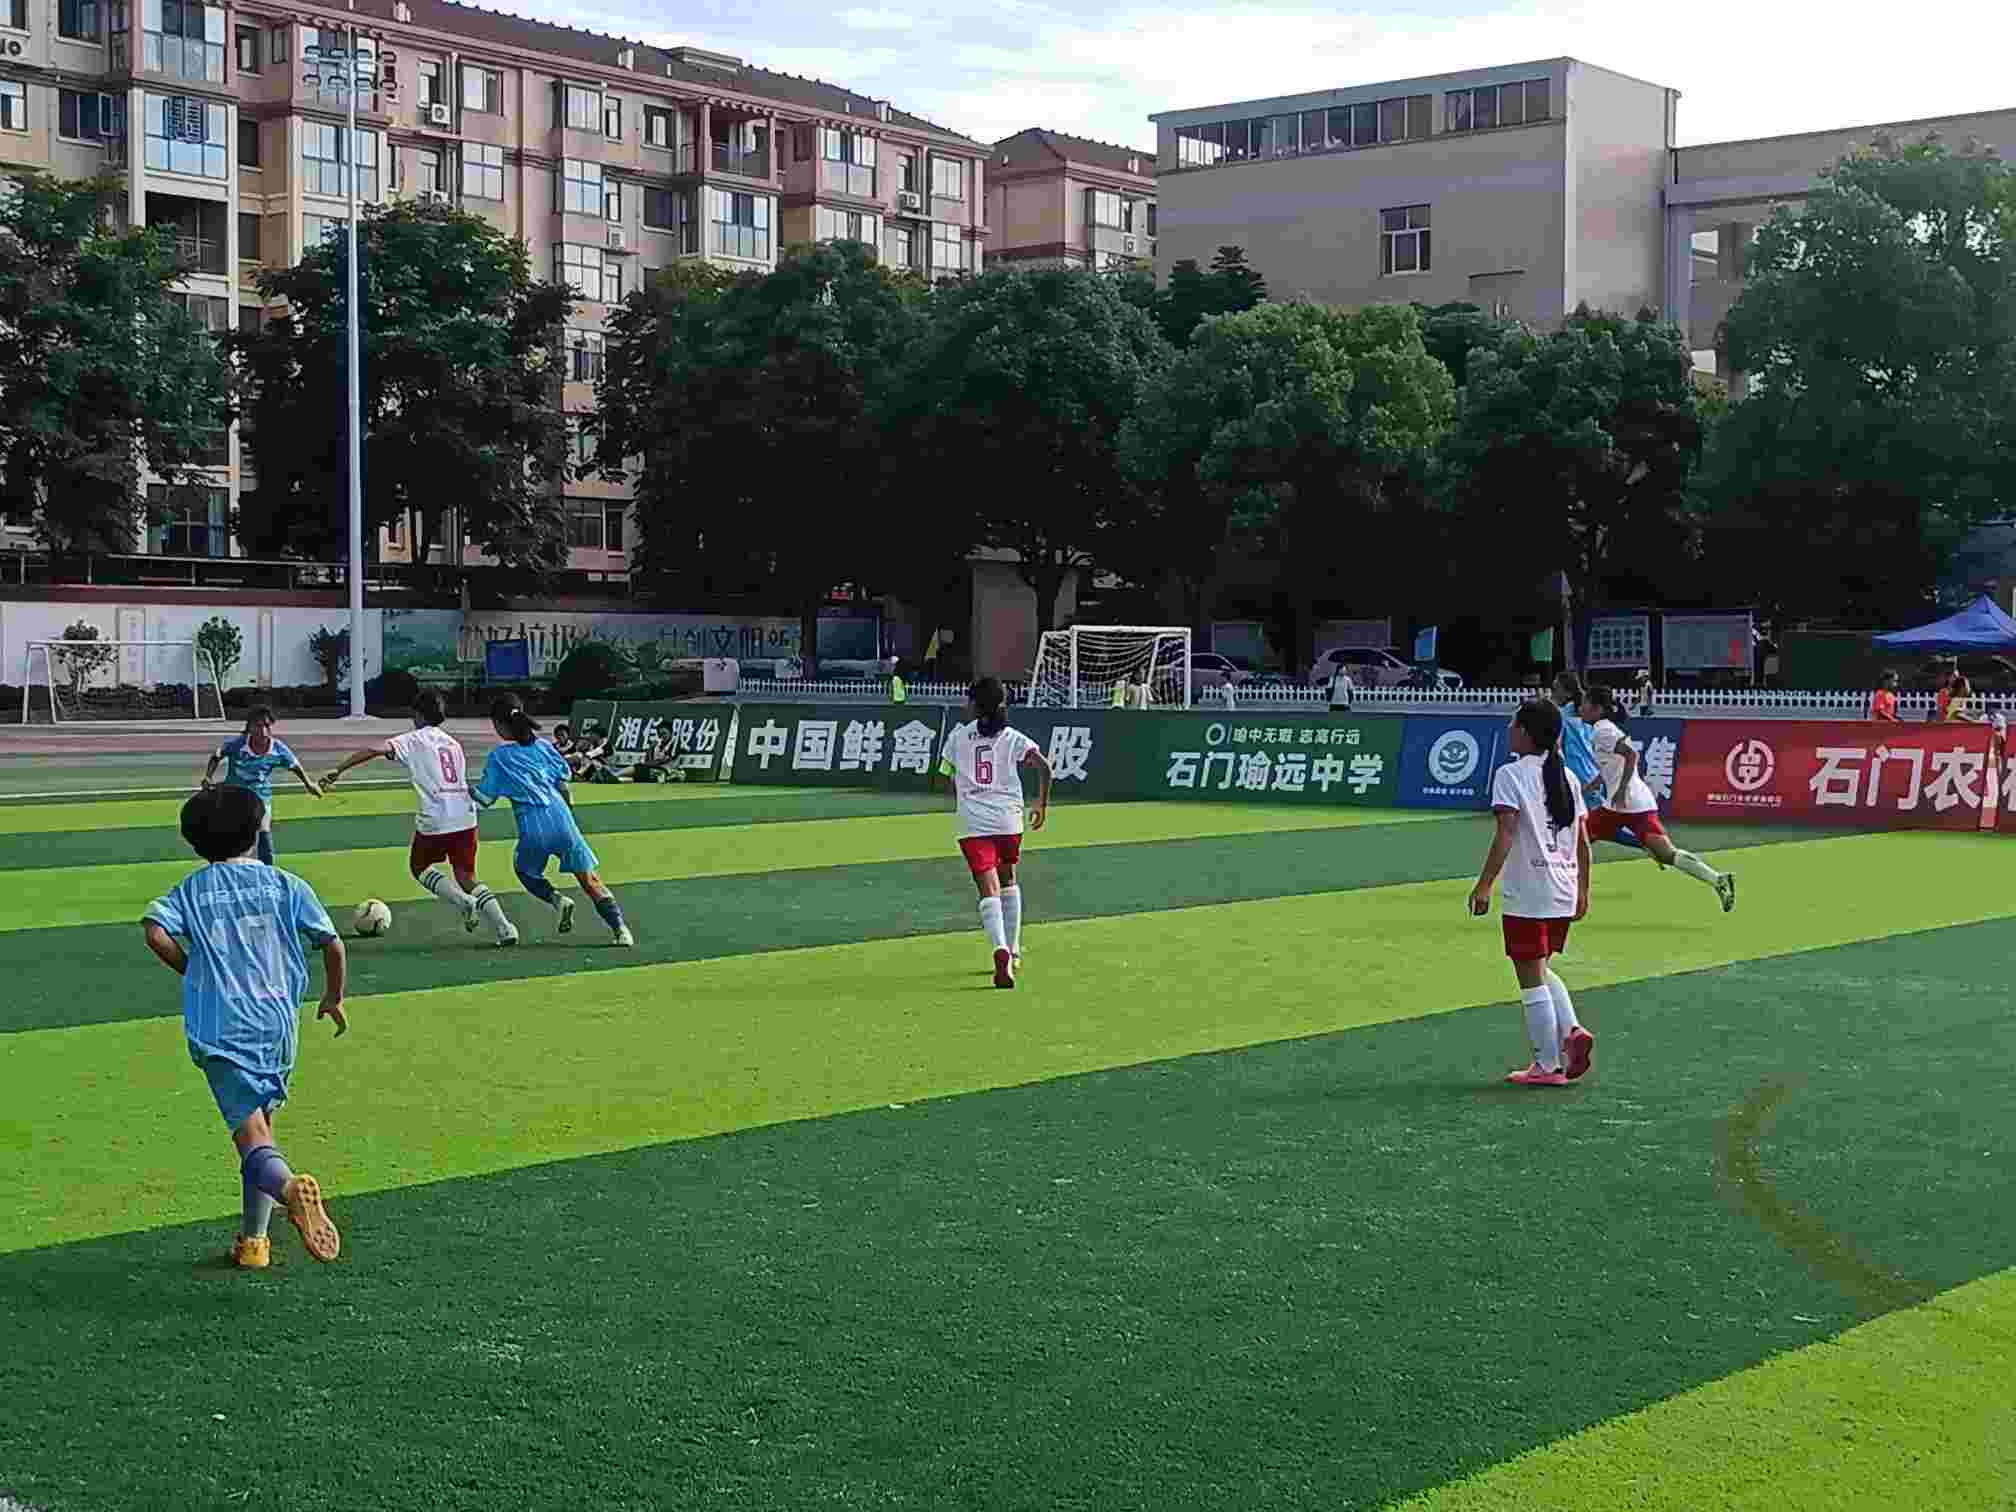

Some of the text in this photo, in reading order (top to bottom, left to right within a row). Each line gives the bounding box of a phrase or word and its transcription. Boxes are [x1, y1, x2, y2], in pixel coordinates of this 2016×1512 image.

[975, 744, 993, 785] 6
[1165, 750, 1385, 795] 石门瑜远中学
[1808, 744, 2016, 812] 石门农
